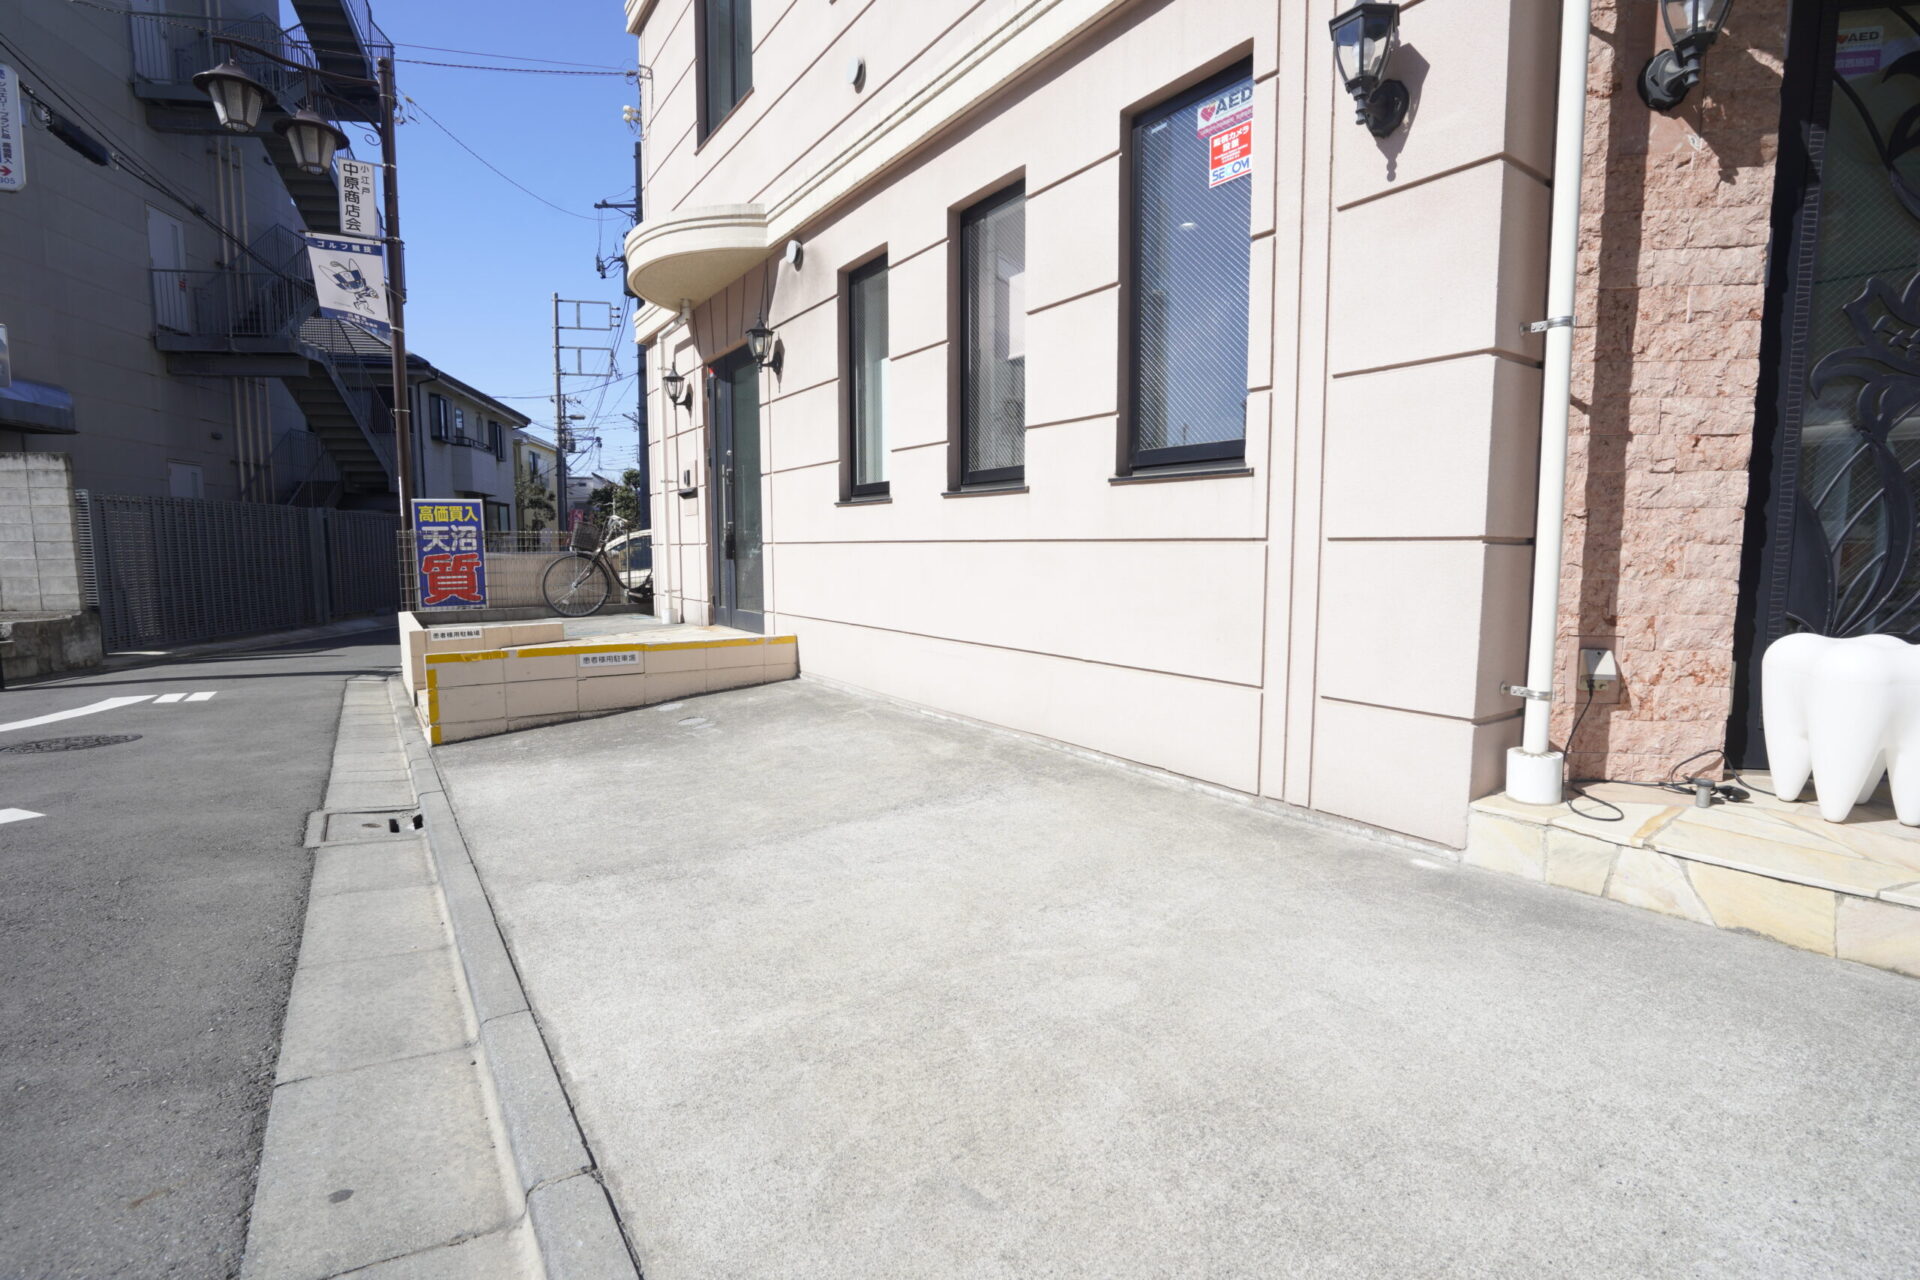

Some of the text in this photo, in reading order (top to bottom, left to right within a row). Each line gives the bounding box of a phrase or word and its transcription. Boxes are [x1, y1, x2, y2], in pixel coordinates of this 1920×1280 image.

[1848, 31, 1880, 42] AED
[1216, 86, 1253, 115] AED
[360, 164, 371, 195] 小江戸
[1212, 157, 1250, 182] SECOM
[343, 163, 362, 232] 中原商店会
[316, 240, 372, 254] ゴルフ競技
[418, 506, 479, 522] 高価買入
[421, 524, 478, 552] 天沼
[421, 552, 483, 605] 質
